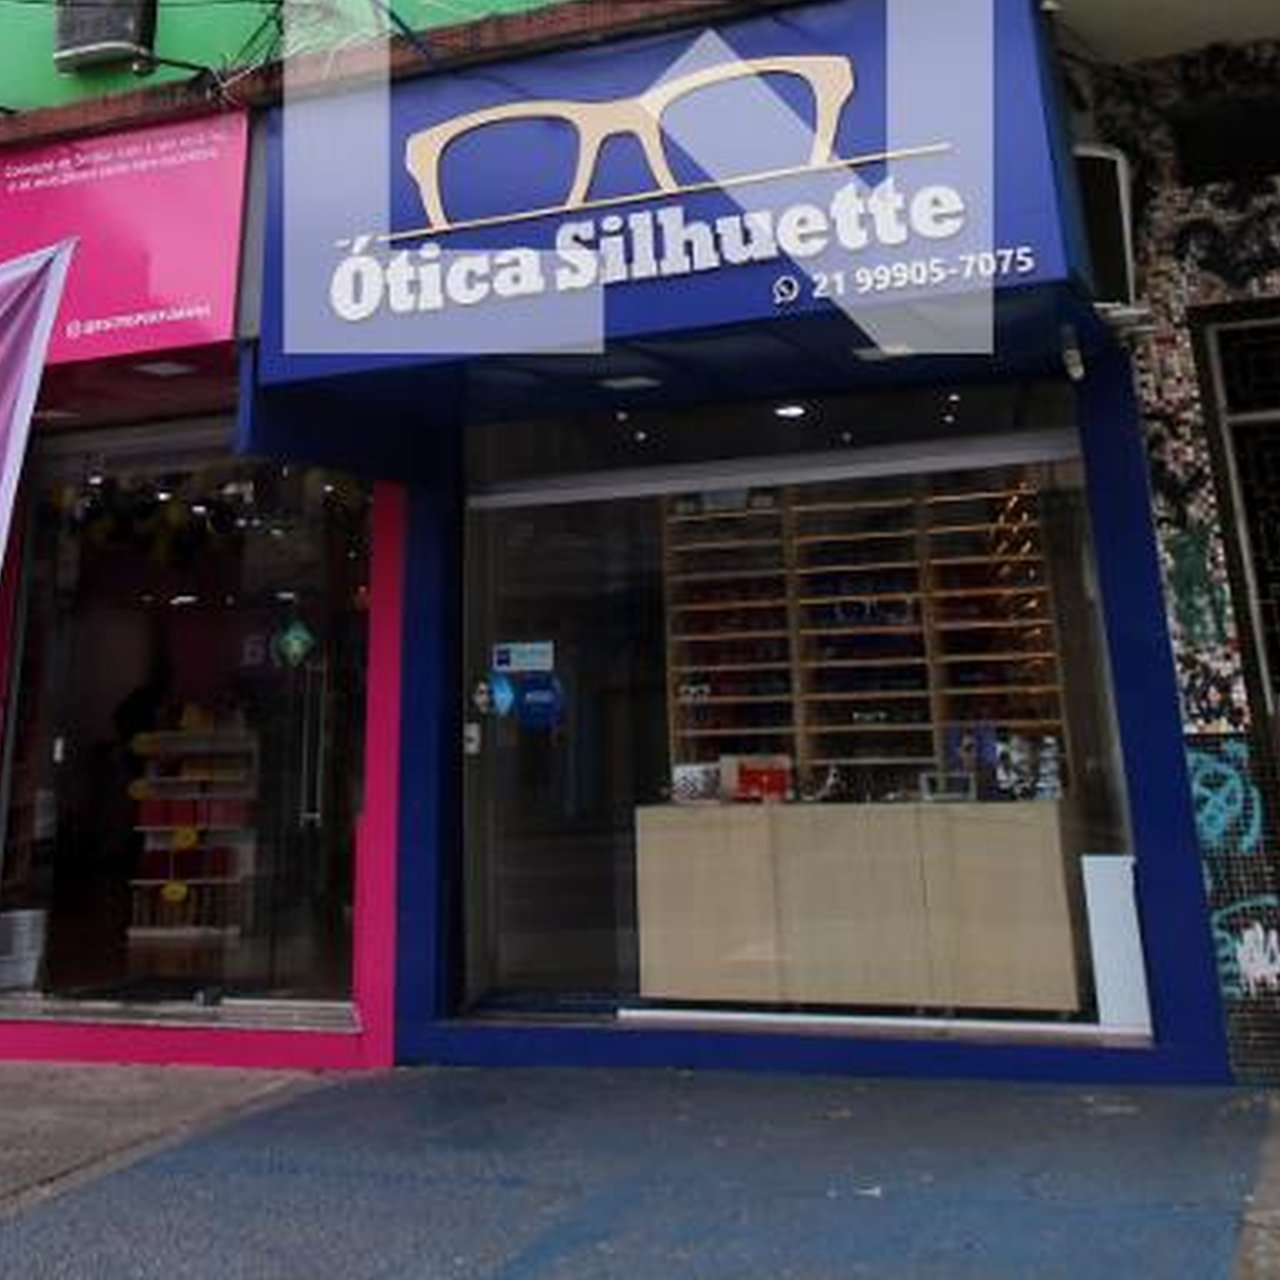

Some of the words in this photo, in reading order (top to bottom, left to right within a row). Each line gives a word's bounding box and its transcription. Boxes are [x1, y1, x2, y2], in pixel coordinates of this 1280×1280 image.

[329, 234, 546, 321] Ótica
[555, 177, 966, 291] Silhuette
[812, 270, 840, 299] 21
[855, 247, 1036, 296] 99905-7075
